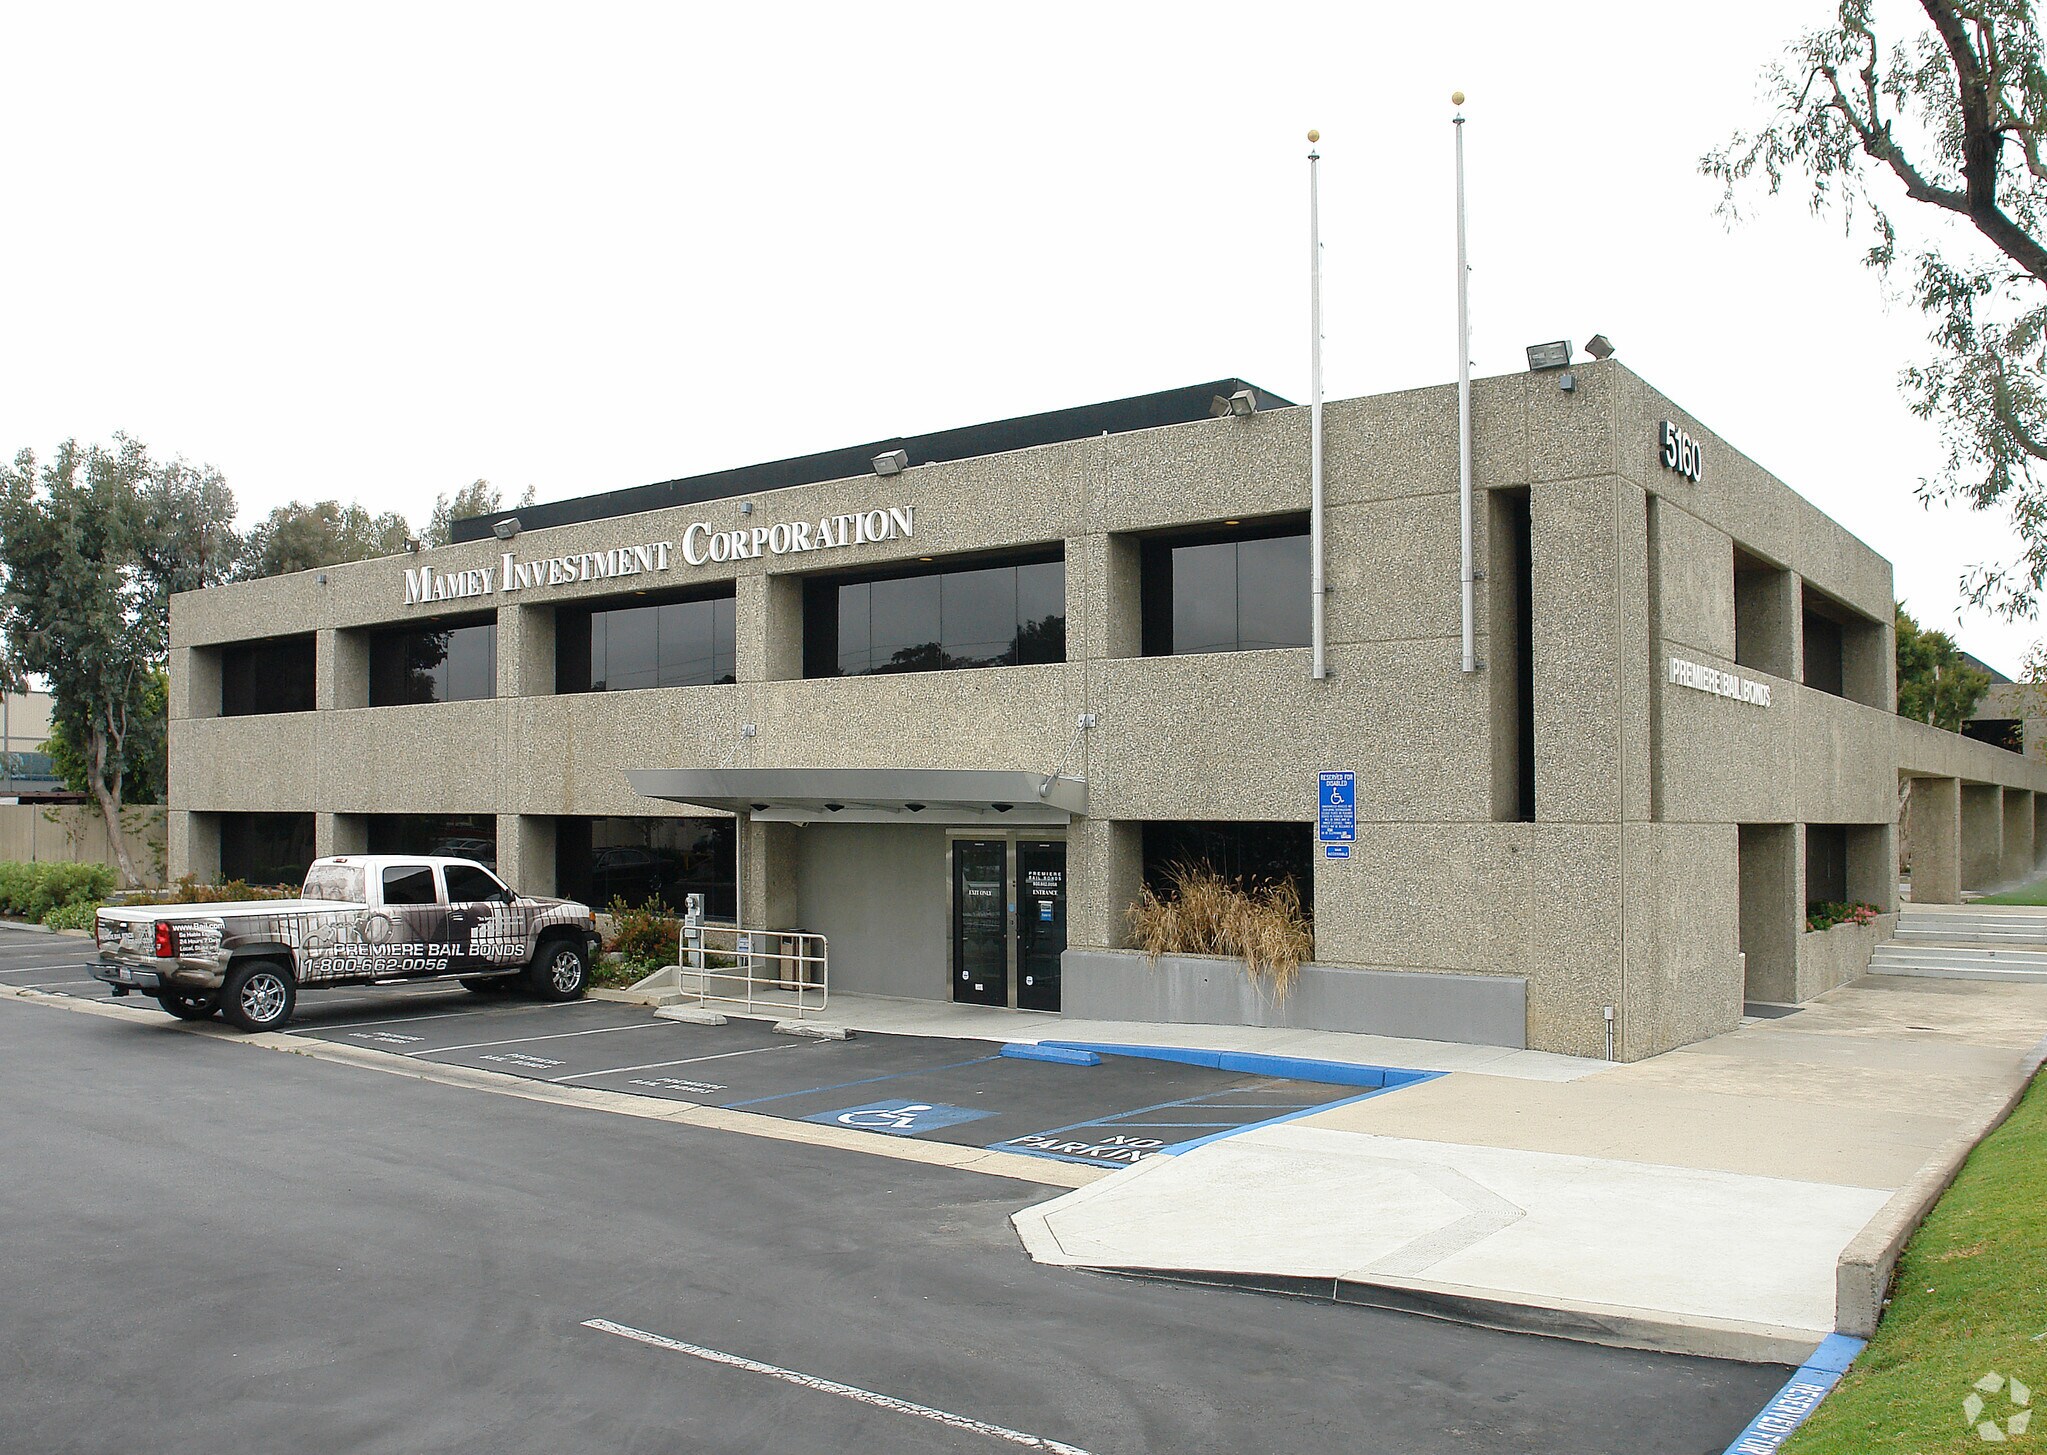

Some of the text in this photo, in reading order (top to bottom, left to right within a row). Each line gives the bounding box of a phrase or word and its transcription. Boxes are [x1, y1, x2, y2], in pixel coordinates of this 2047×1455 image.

[1662, 420, 1702, 482] 5160
[402, 504, 915, 605] MAMEY INVESTMENT CORPORATION
[1669, 657, 1771, 708] PREMIERE BAIL BONDS
[304, 957, 449, 972] 1-800-662-0056
[333, 943, 526, 957] PREMIERE BAIL BONDS
[1005, 1135, 1154, 1162] PARKIN
[1099, 1135, 1164, 1148] NO
[1755, 1382, 1826, 1433] RESERVED
